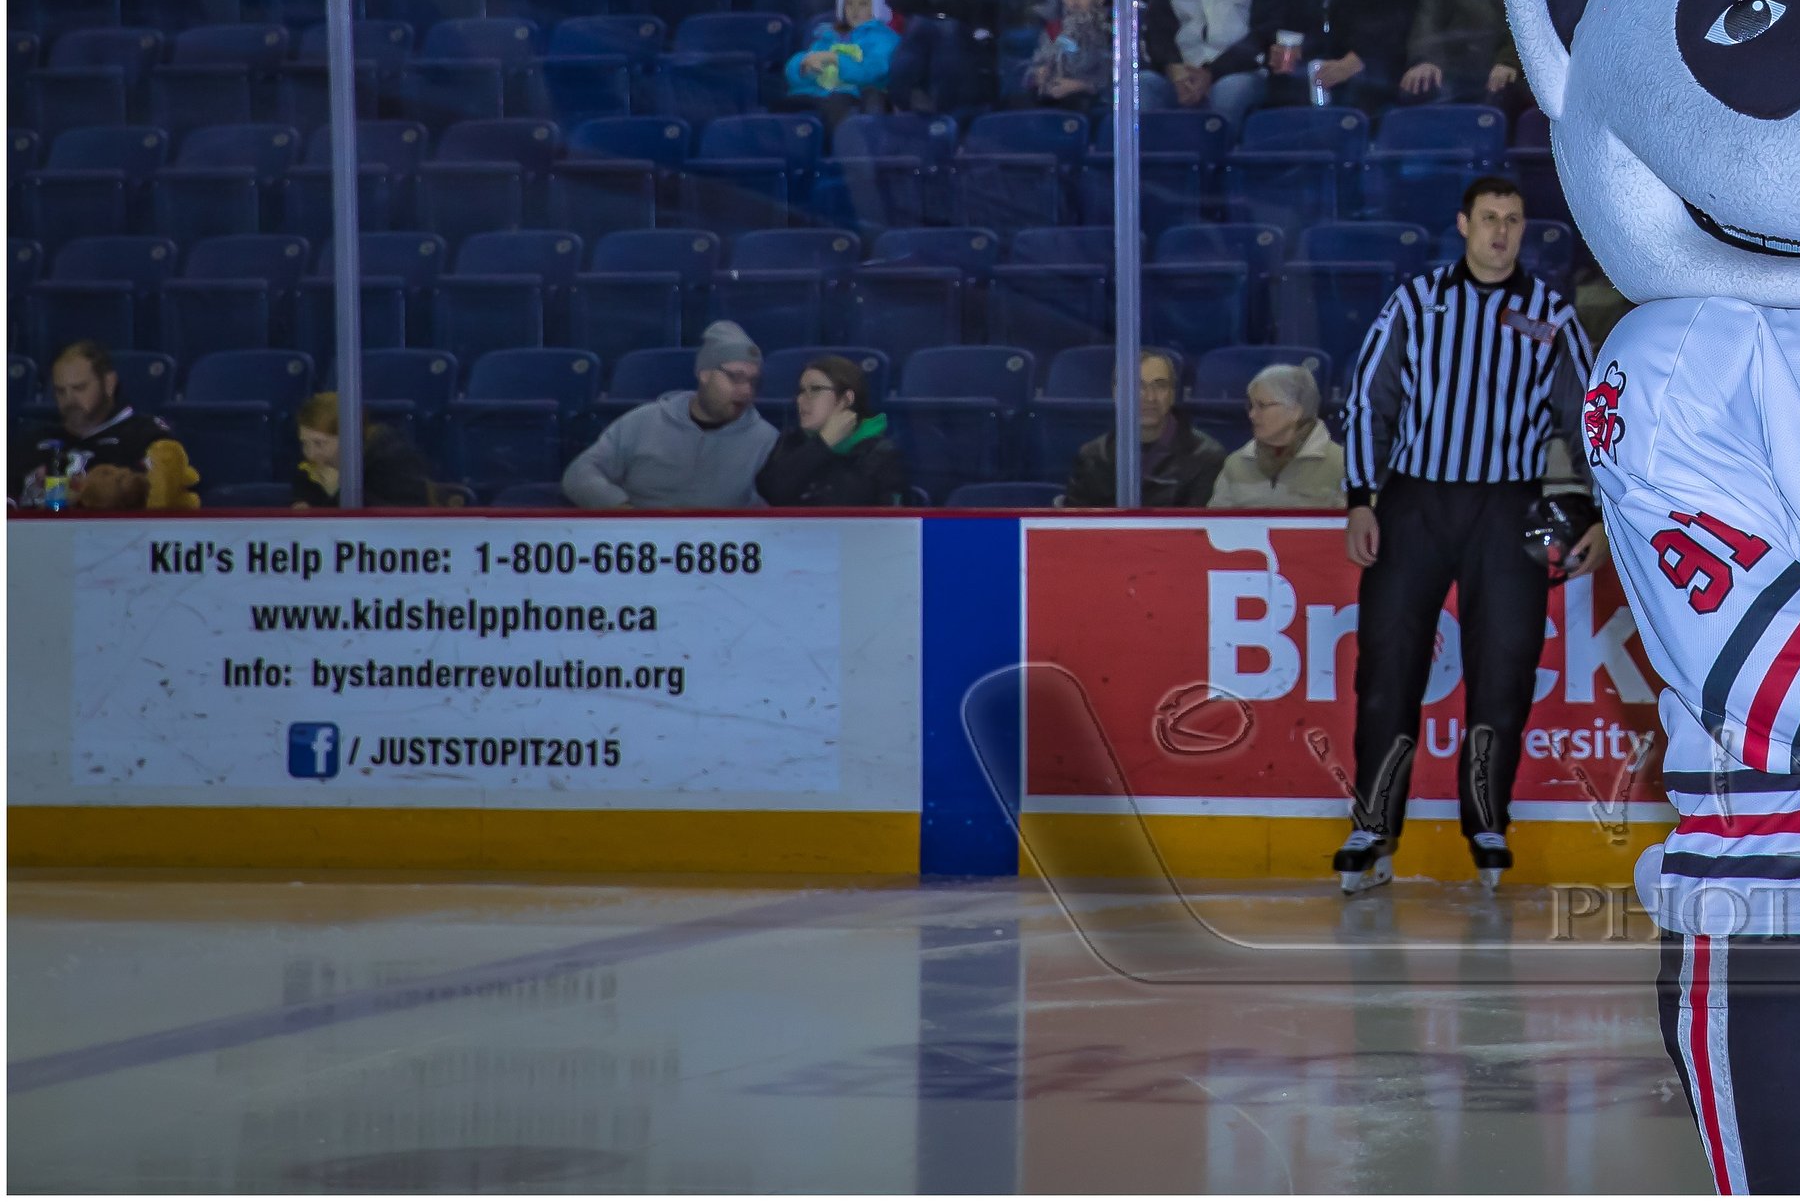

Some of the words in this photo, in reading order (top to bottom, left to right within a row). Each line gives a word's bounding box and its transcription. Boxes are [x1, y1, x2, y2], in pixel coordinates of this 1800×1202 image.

[150, 541, 234, 574] Kid's
[247, 541, 322, 581] Help
[334, 541, 452, 574] Phone:
[475, 541, 762, 574] 1-800-668-6868
[1650, 510, 1773, 616] 91
[252, 598, 658, 638] www.kidshelpphone.ca
[224, 657, 292, 687] Info:
[312, 658, 685, 695] bystanderrevolution.org
[371, 737, 621, 767] JUSTSTOPIT2015
[1426, 716, 1656, 771] Uersity
